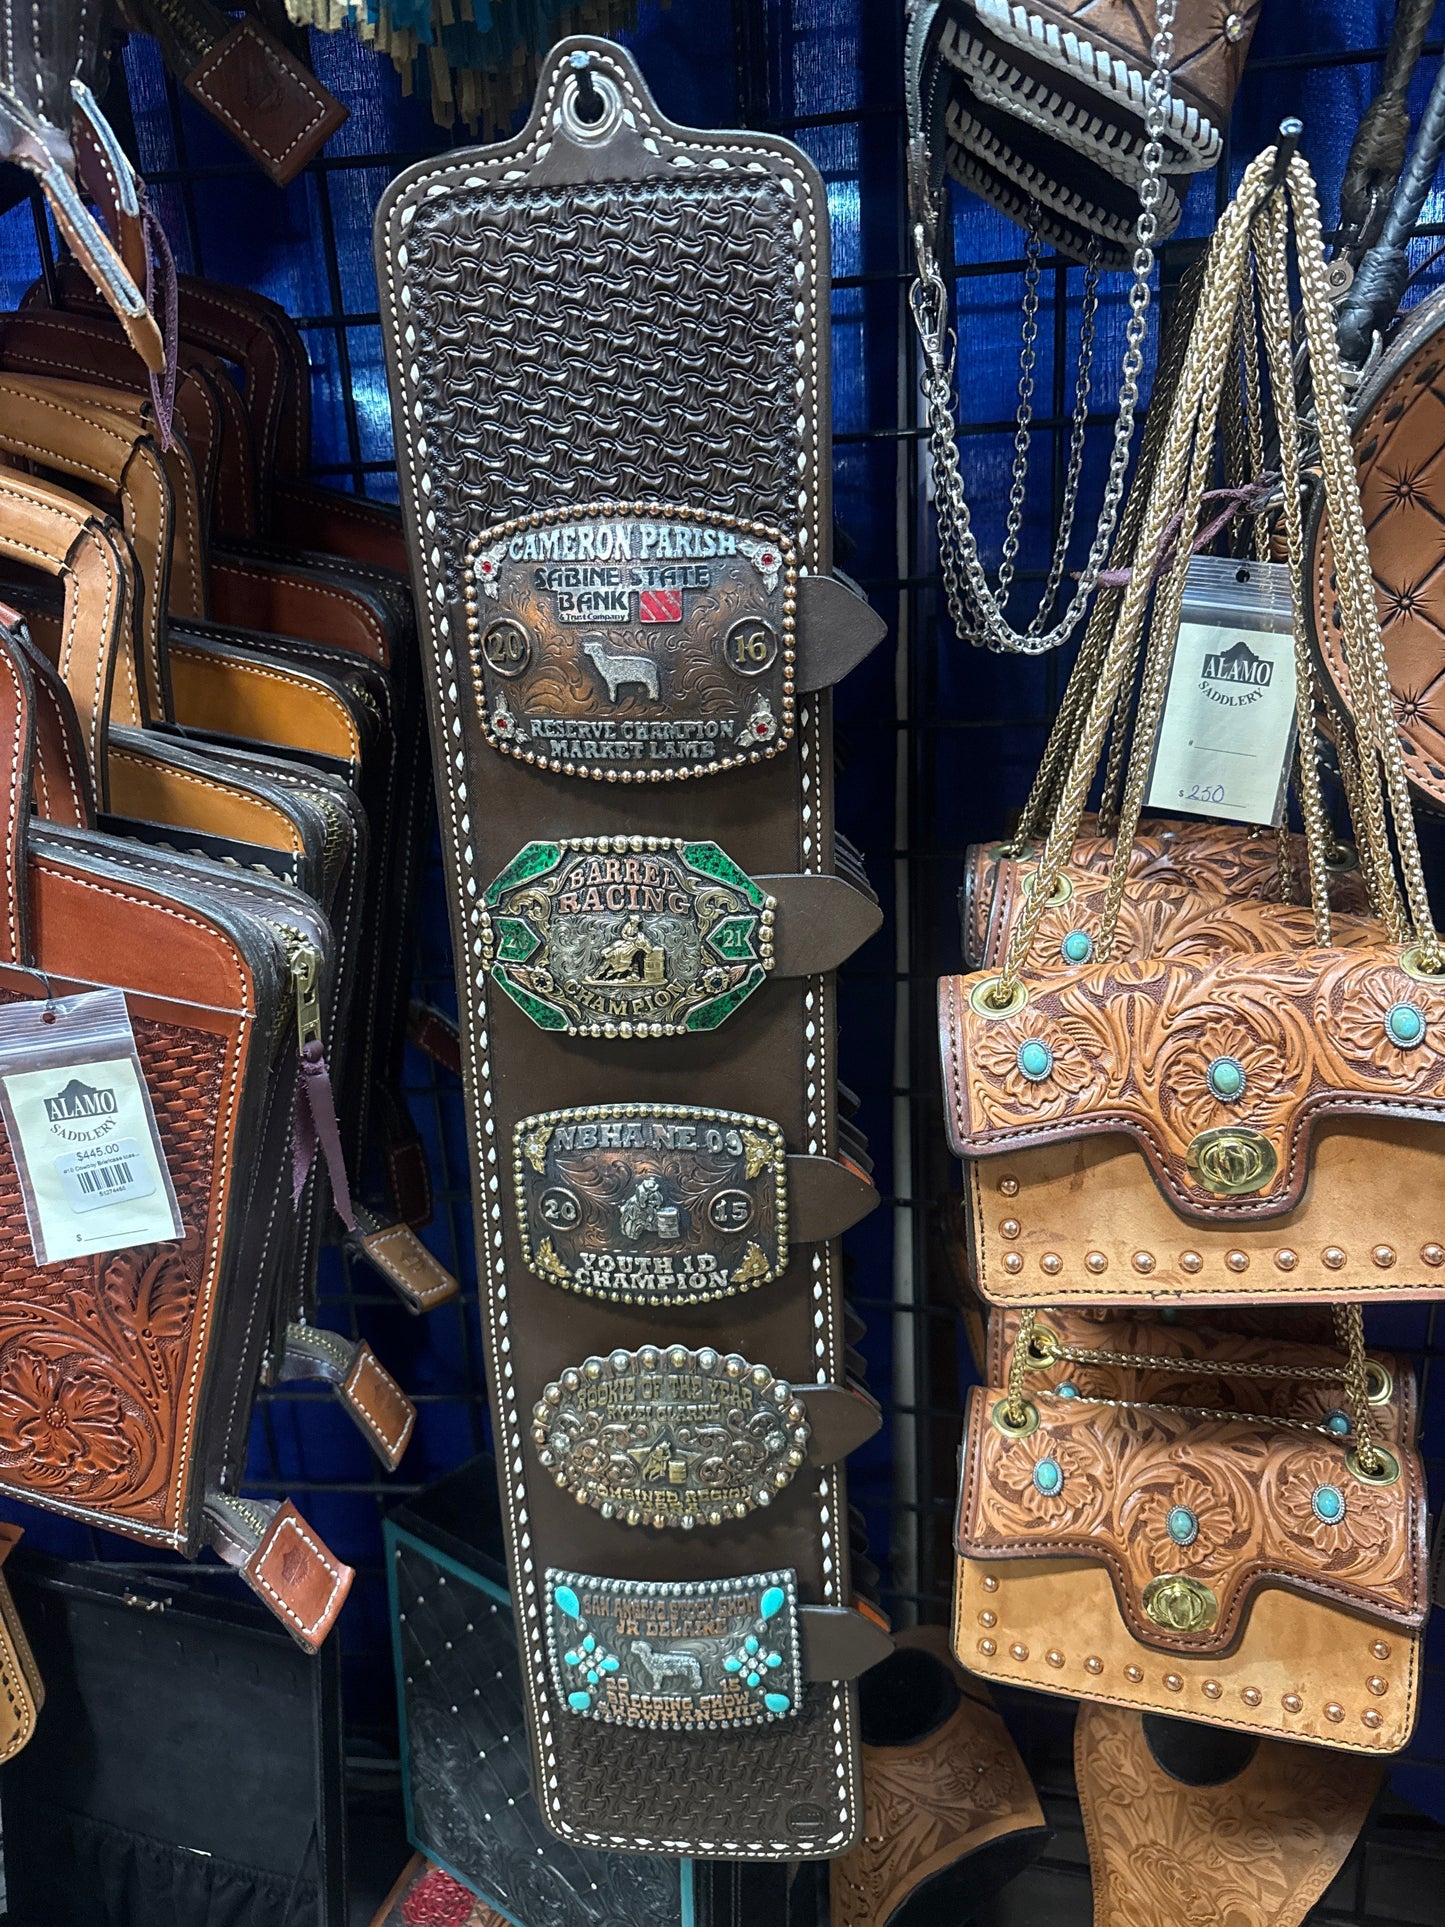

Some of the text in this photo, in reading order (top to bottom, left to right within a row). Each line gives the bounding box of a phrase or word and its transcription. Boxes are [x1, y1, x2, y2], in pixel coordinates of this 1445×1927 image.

[509, 523, 737, 562] CAMERON PARISH
[534, 565, 710, 589] SABINE STATE
[559, 591, 628, 613] BANK
[587, 613, 625, 621] Company
[487, 632, 523, 661] 20
[735, 631, 768, 663] 16
[1204, 656, 1271, 685] ALAMO
[1198, 680, 1264, 707] SADDLERY
[530, 720, 734, 739] RESERVE CHAMPION
[550, 740, 715, 759] MARKET LAMB
[1185, 784, 1225, 803] 250
[569, 858, 679, 890] BARREL
[559, 886, 691, 914] RACING
[722, 930, 742, 947] 21
[564, 979, 686, 1016] CHAMPION
[50, 1090, 115, 1120] ALAMO
[50, 1116, 117, 1142] SADDLERY
[554, 1124, 743, 1156] NBHA NE 09
[76, 1144, 119, 1161] $445.00
[544, 1200, 576, 1220] 20
[714, 1199, 748, 1222] 15
[76, 1234, 82, 1242] $
[579, 1253, 718, 1274] YOUTH 1D
[574, 1270, 729, 1290] CHAMPION
[577, 1375, 753, 1411] ROOKIE OF THE YEAR
[685, 1485, 753, 1501] REGION
[583, 1594, 609, 1616] SAN
[616, 1618, 639, 1635] JR
[720, 1678, 741, 1692] 15
[606, 1691, 750, 1710] BREEDING SHOW
